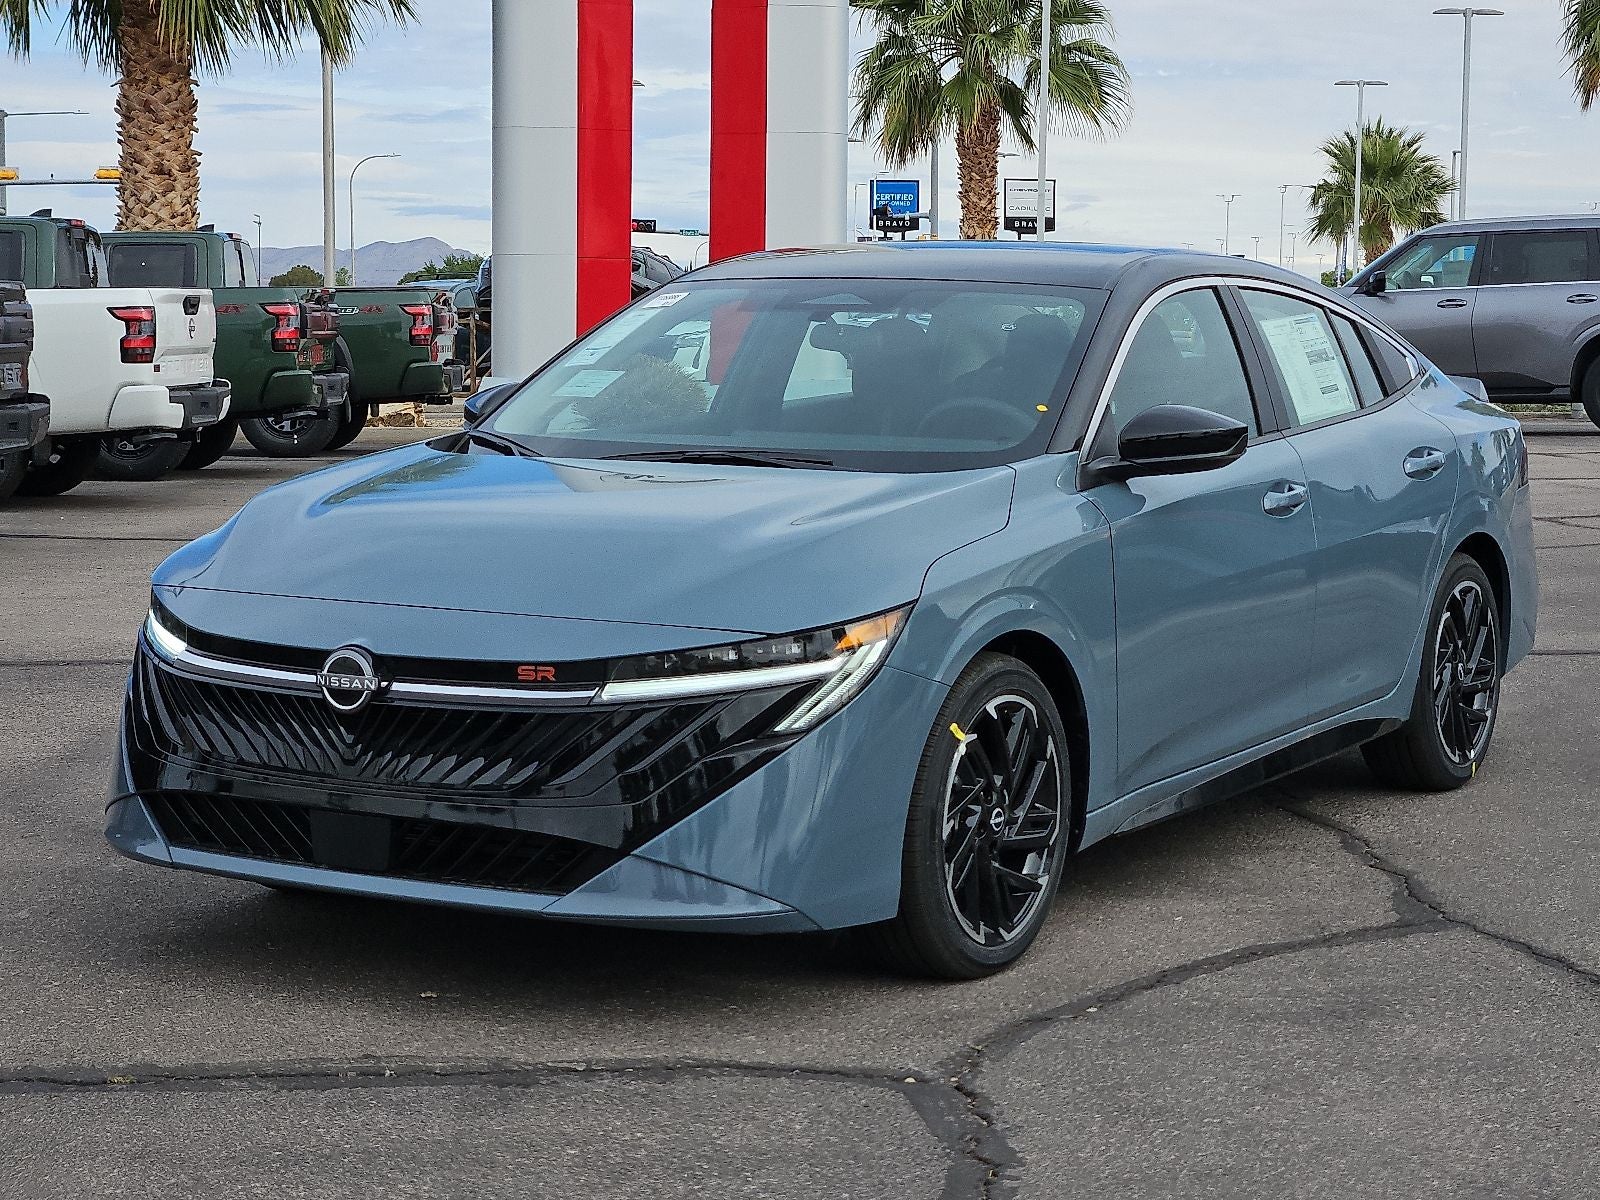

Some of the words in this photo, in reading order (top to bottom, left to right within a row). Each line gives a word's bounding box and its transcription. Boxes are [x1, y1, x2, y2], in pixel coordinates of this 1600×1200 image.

[876, 193, 914, 201] CERTIFIED
[1014, 220, 1038, 228] BRAV
[517, 665, 557, 681] SR
[316, 673, 377, 690] NISSAN
